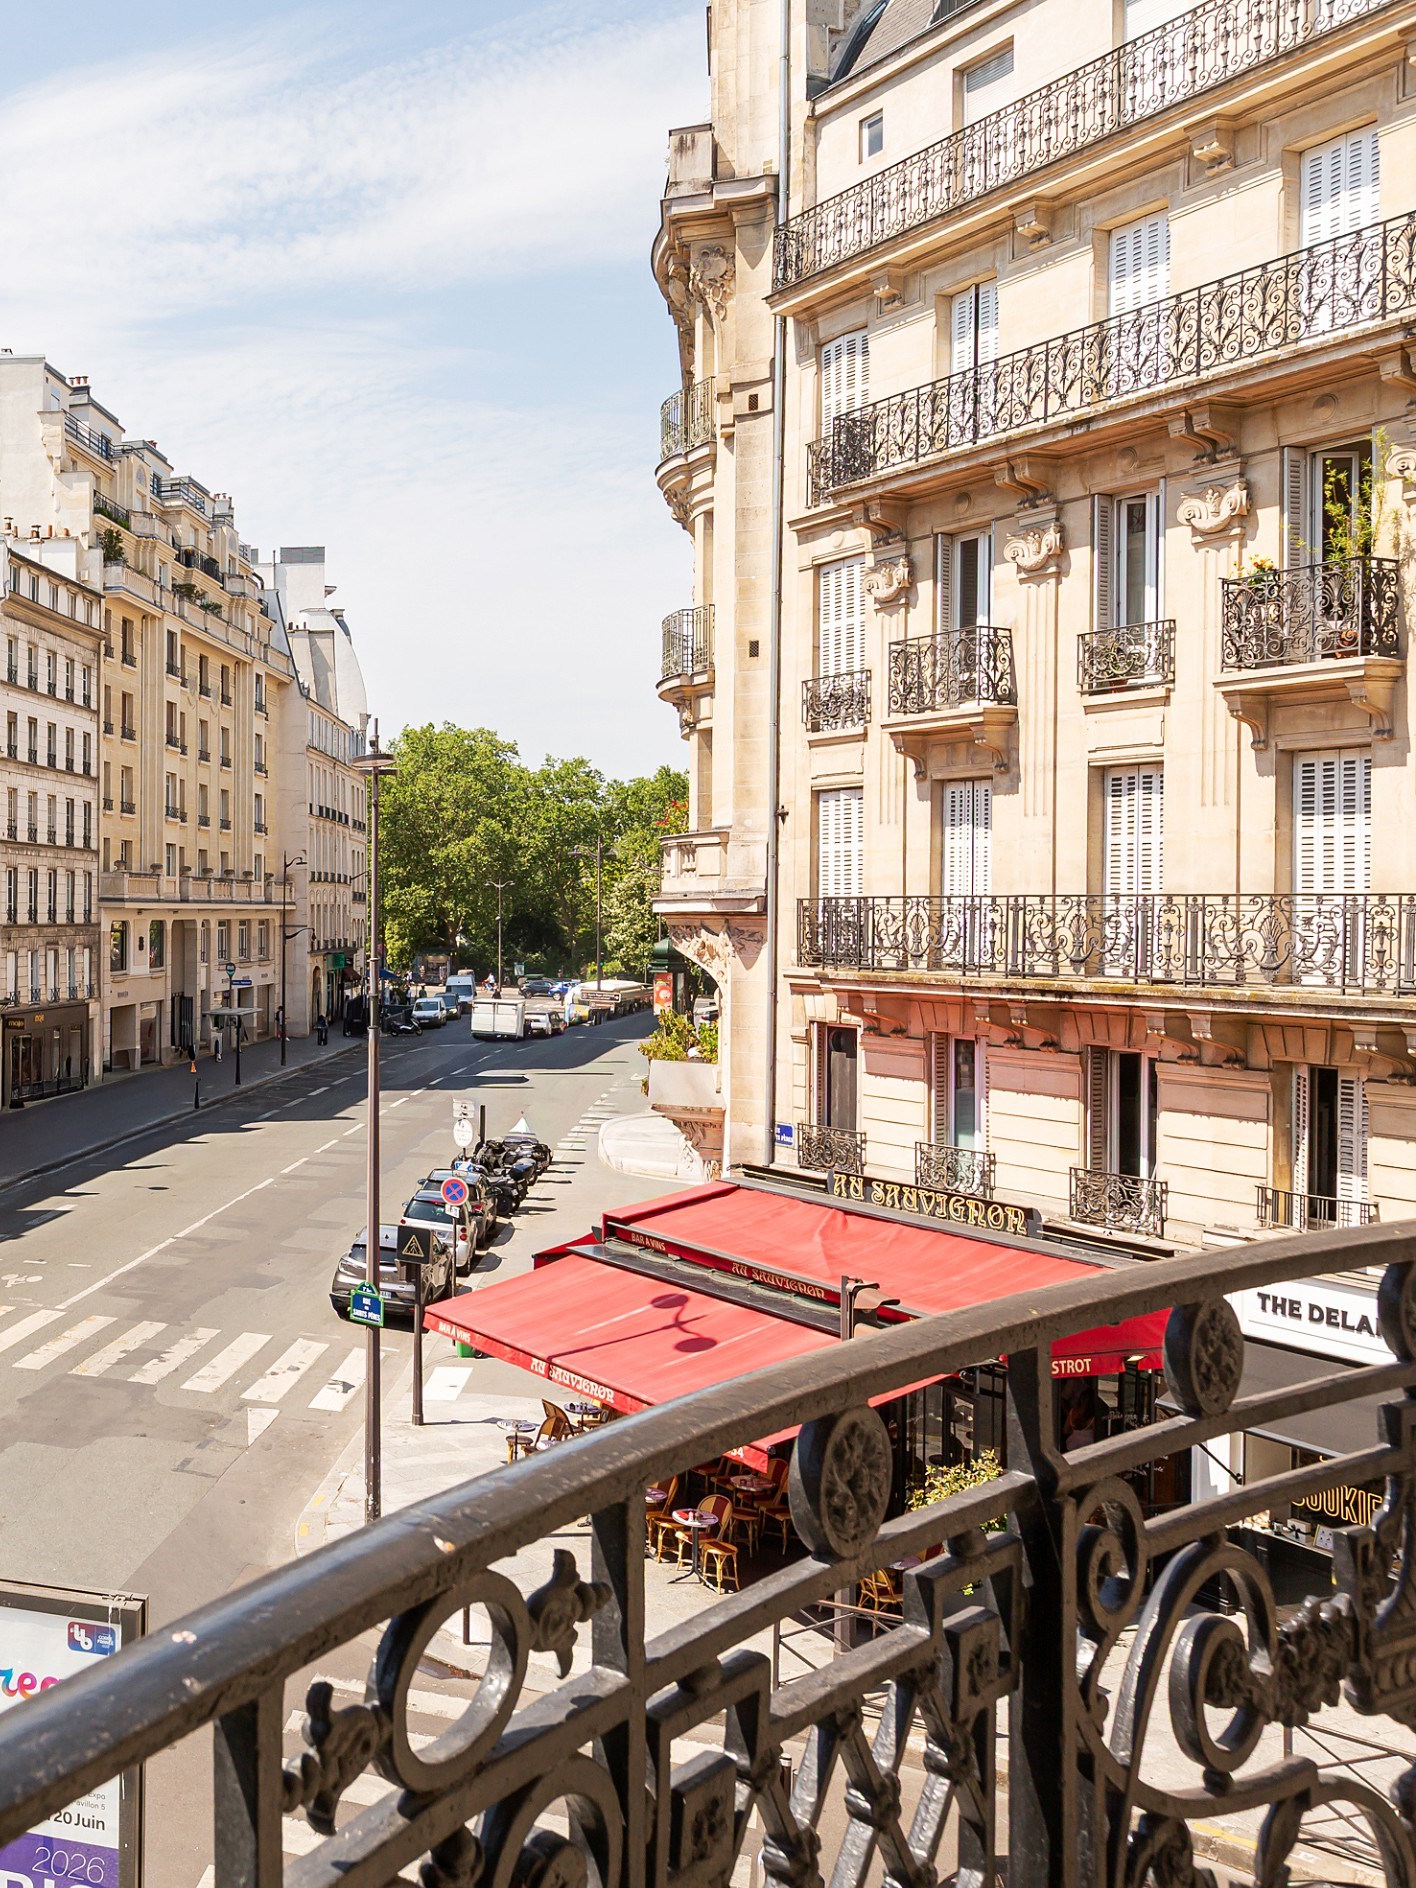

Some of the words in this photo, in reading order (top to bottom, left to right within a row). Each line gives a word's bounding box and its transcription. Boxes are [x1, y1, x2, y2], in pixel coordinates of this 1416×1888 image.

[833, 1174, 864, 1200] AU
[872, 1180, 1027, 1235] SAUVIGNON
[631, 1233, 645, 1245] BAR
[650, 1238, 666, 1251] VINS
[732, 1263, 747, 1276] AU
[752, 1268, 827, 1300] SAUVIGNON
[438, 1321, 451, 1335] BAR
[456, 1328, 471, 1343] VINS
[1257, 1292, 1302, 1320] THE
[1308, 1303, 1384, 1338] DELA
[530, 1357, 547, 1375] AU
[549, 1364, 615, 1404] SAUVIGNON
[1051, 1358, 1092, 1375] STROT
[1292, 1485, 1383, 1527] OOKIE
[53, 1811, 73, 1825] 20
[74, 1813, 105, 1831] Juin
[100, 1803, 106, 1811] 5
[32, 1846, 105, 1883] 2026
